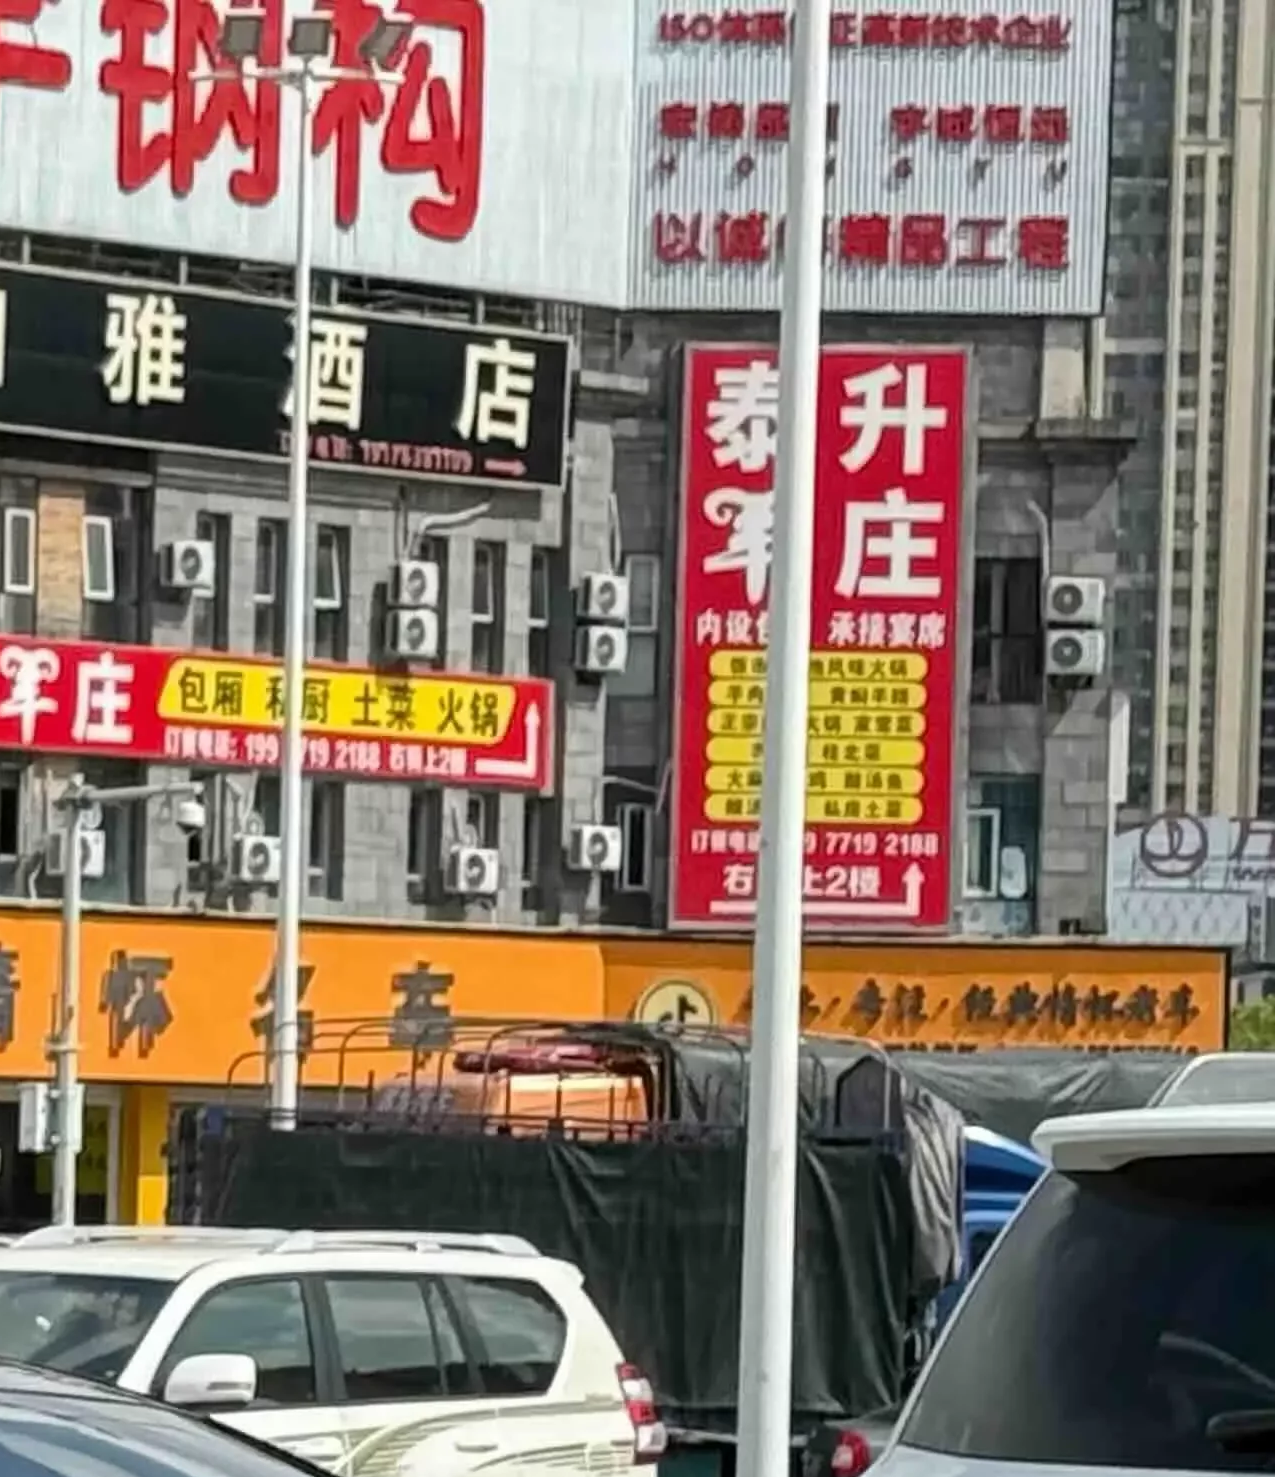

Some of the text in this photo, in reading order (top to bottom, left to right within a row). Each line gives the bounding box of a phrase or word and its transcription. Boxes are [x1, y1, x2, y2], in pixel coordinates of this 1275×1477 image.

[178, 666, 244, 718] 包厢
[351, 682, 417, 731] 土菜
[437, 688, 499, 738] 火锅
